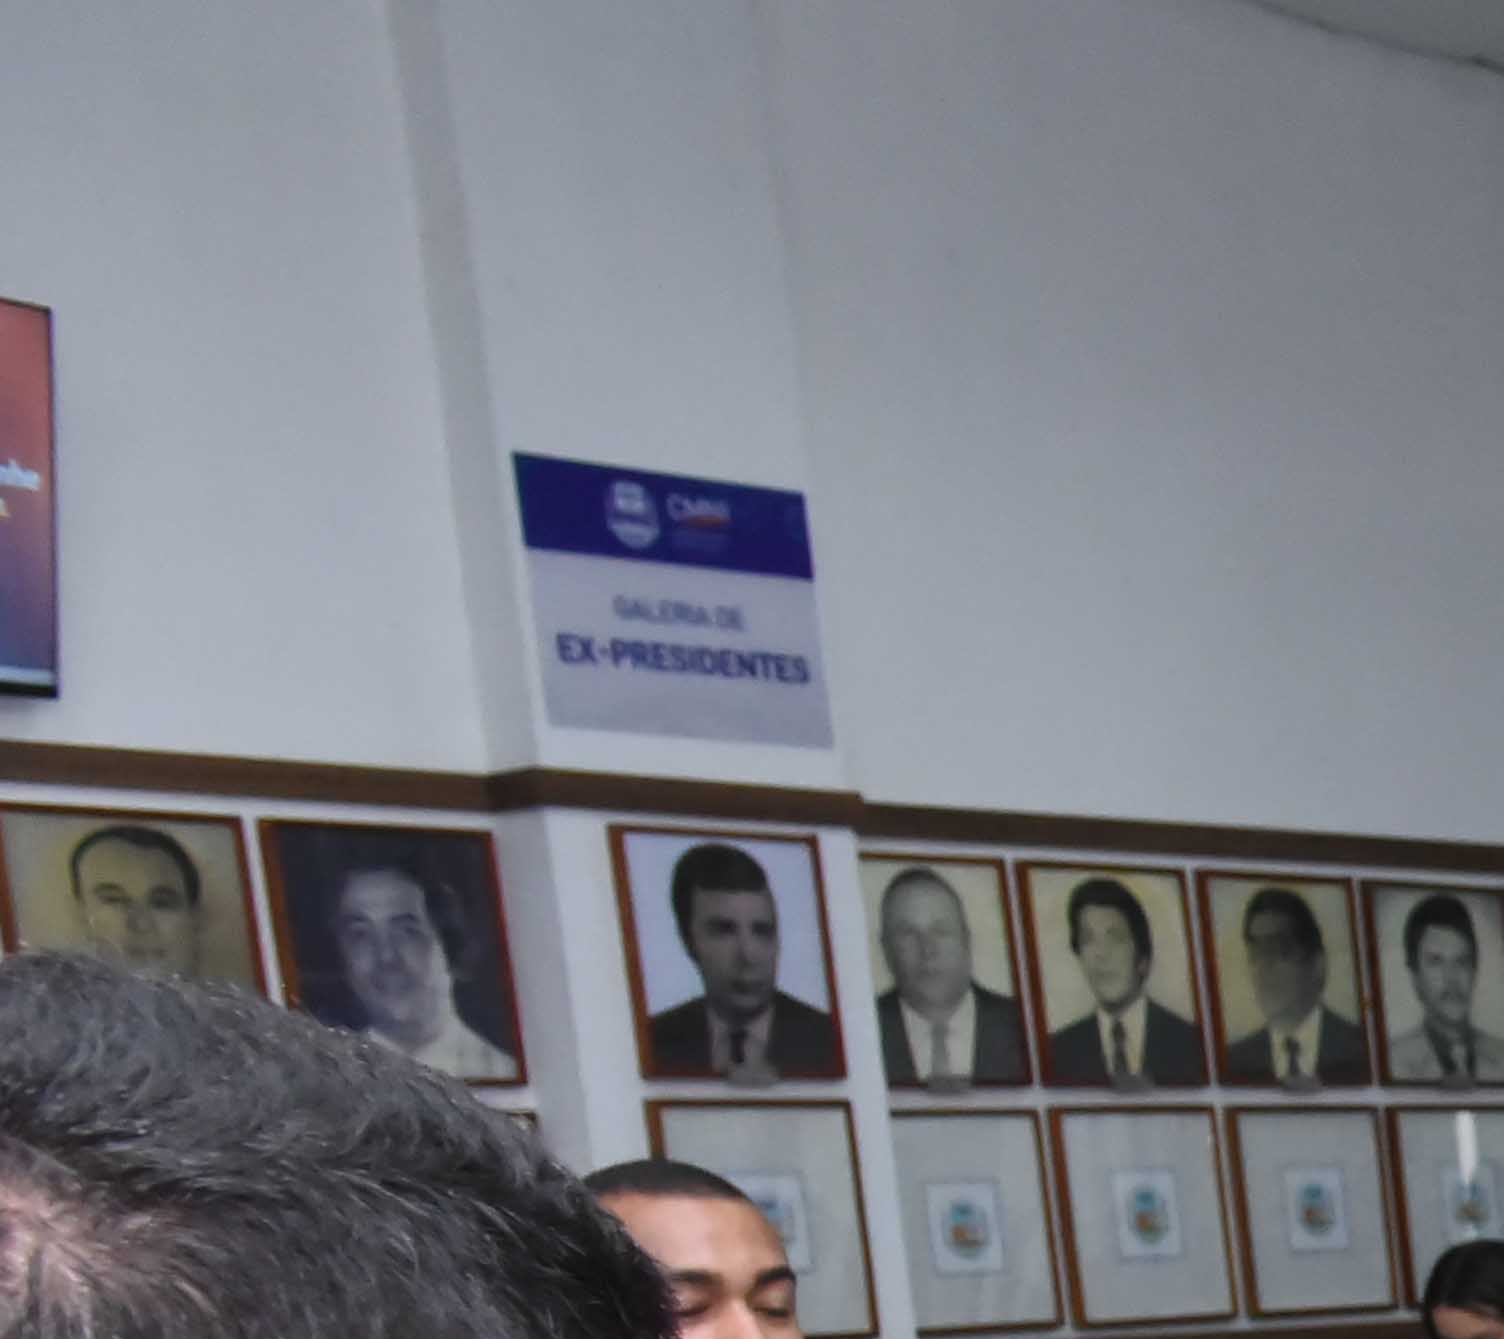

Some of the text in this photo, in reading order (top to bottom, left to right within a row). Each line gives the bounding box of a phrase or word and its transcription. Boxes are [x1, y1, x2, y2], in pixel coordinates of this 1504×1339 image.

[613, 595, 744, 632] GALERIA DE
[557, 633, 810, 684] EX-PRESIDENTES
